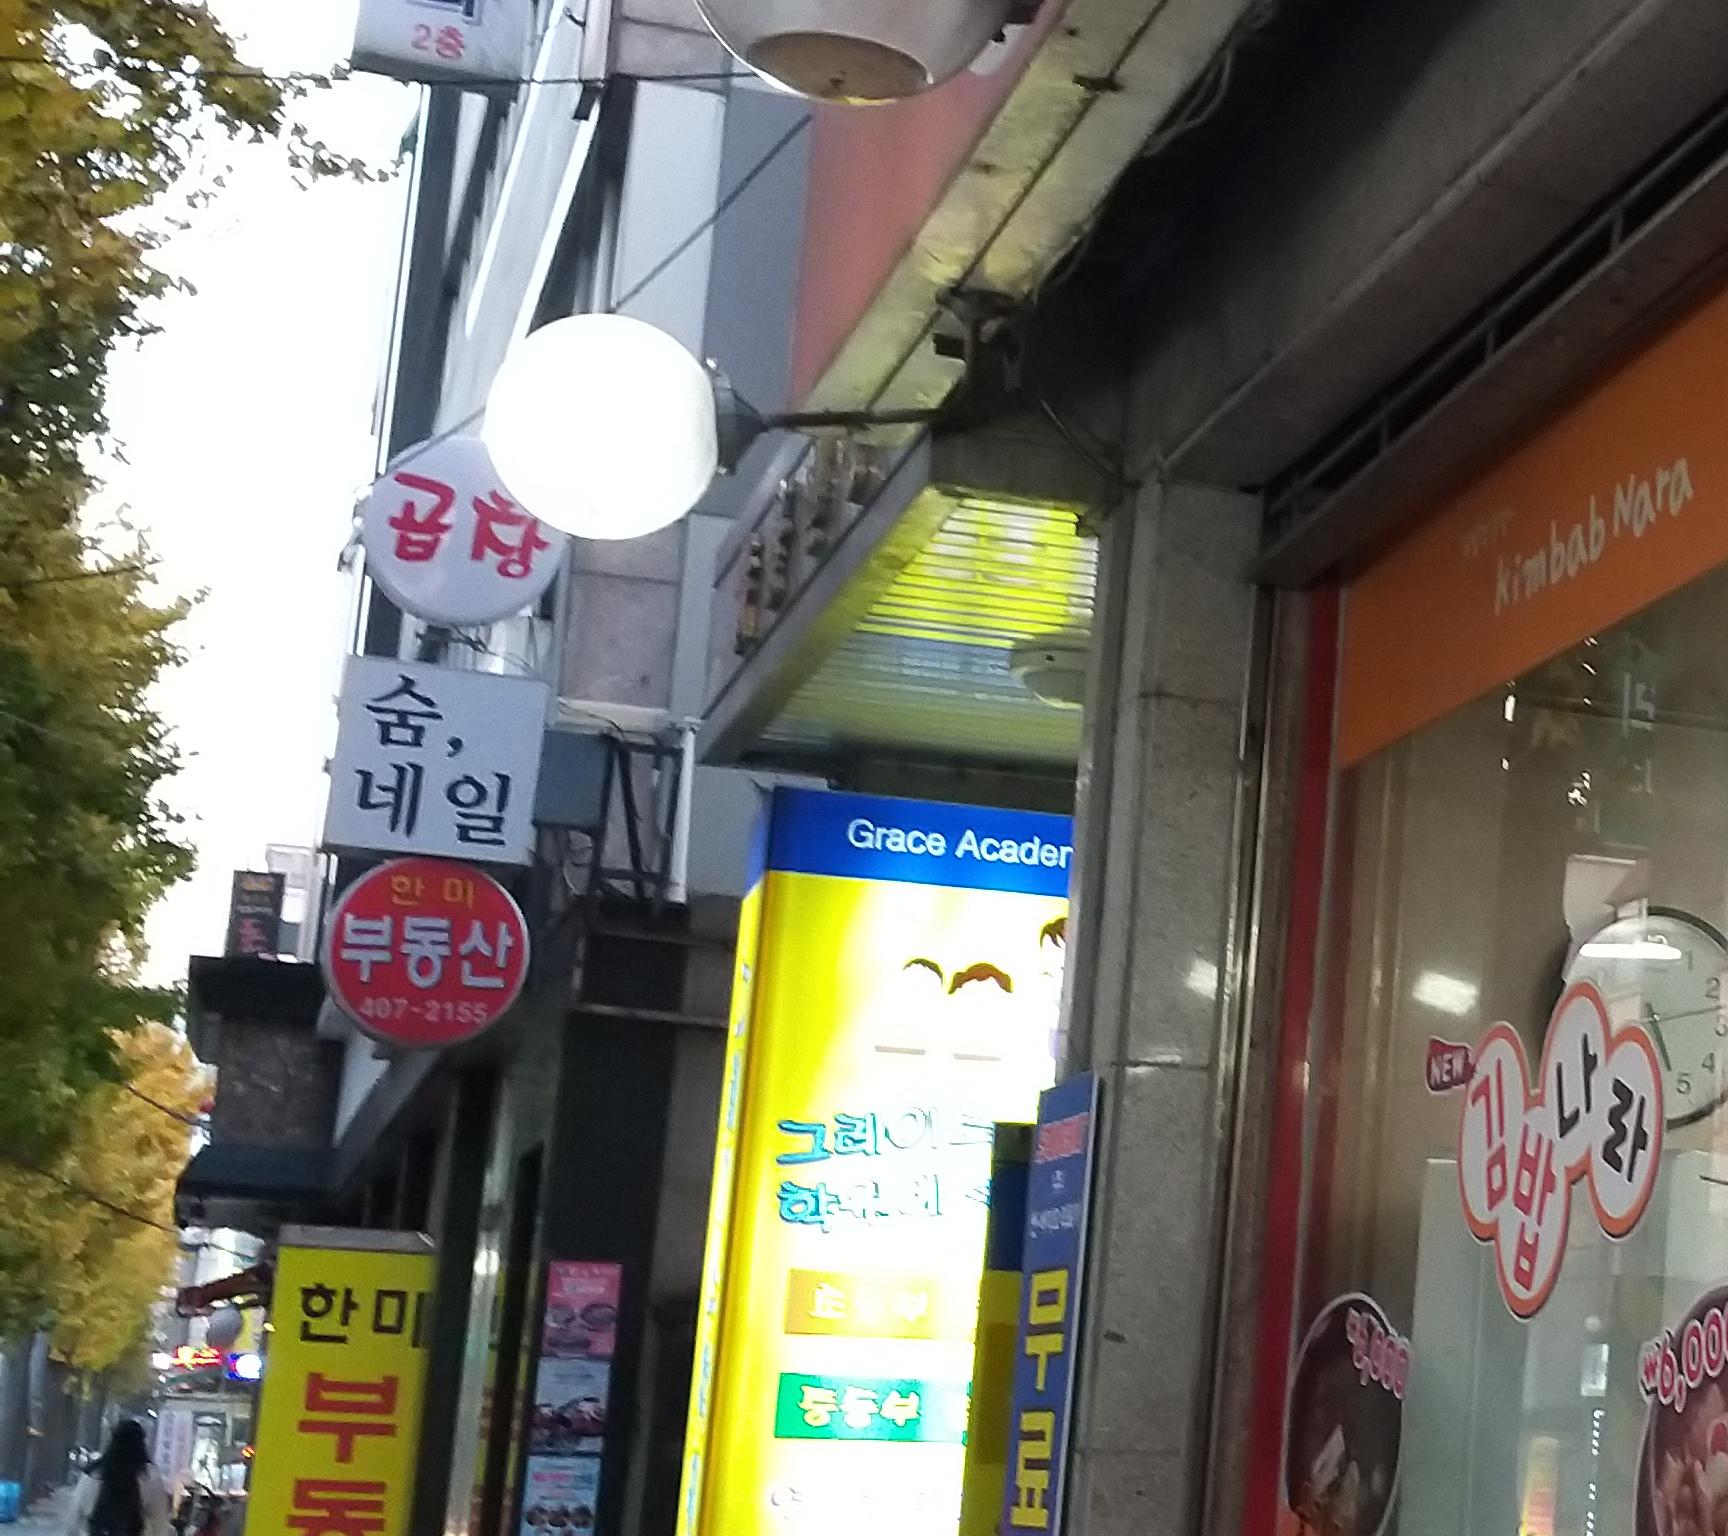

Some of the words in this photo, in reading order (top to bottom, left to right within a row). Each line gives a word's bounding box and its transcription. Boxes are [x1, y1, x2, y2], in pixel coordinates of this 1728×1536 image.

[387, 469, 551, 581] 곱창
[355, 763, 511, 848] 네일
[846, 817, 947, 857] Grace
[390, 874, 475, 909] 한미
[340, 912, 516, 990] 부동산
[359, 996, 490, 1025] 407-2155
[1429, 1047, 1466, 1088] NEW
[1471, 1030, 1649, 1292] 김밥나라
[298, 1281, 433, 1350] 한미
